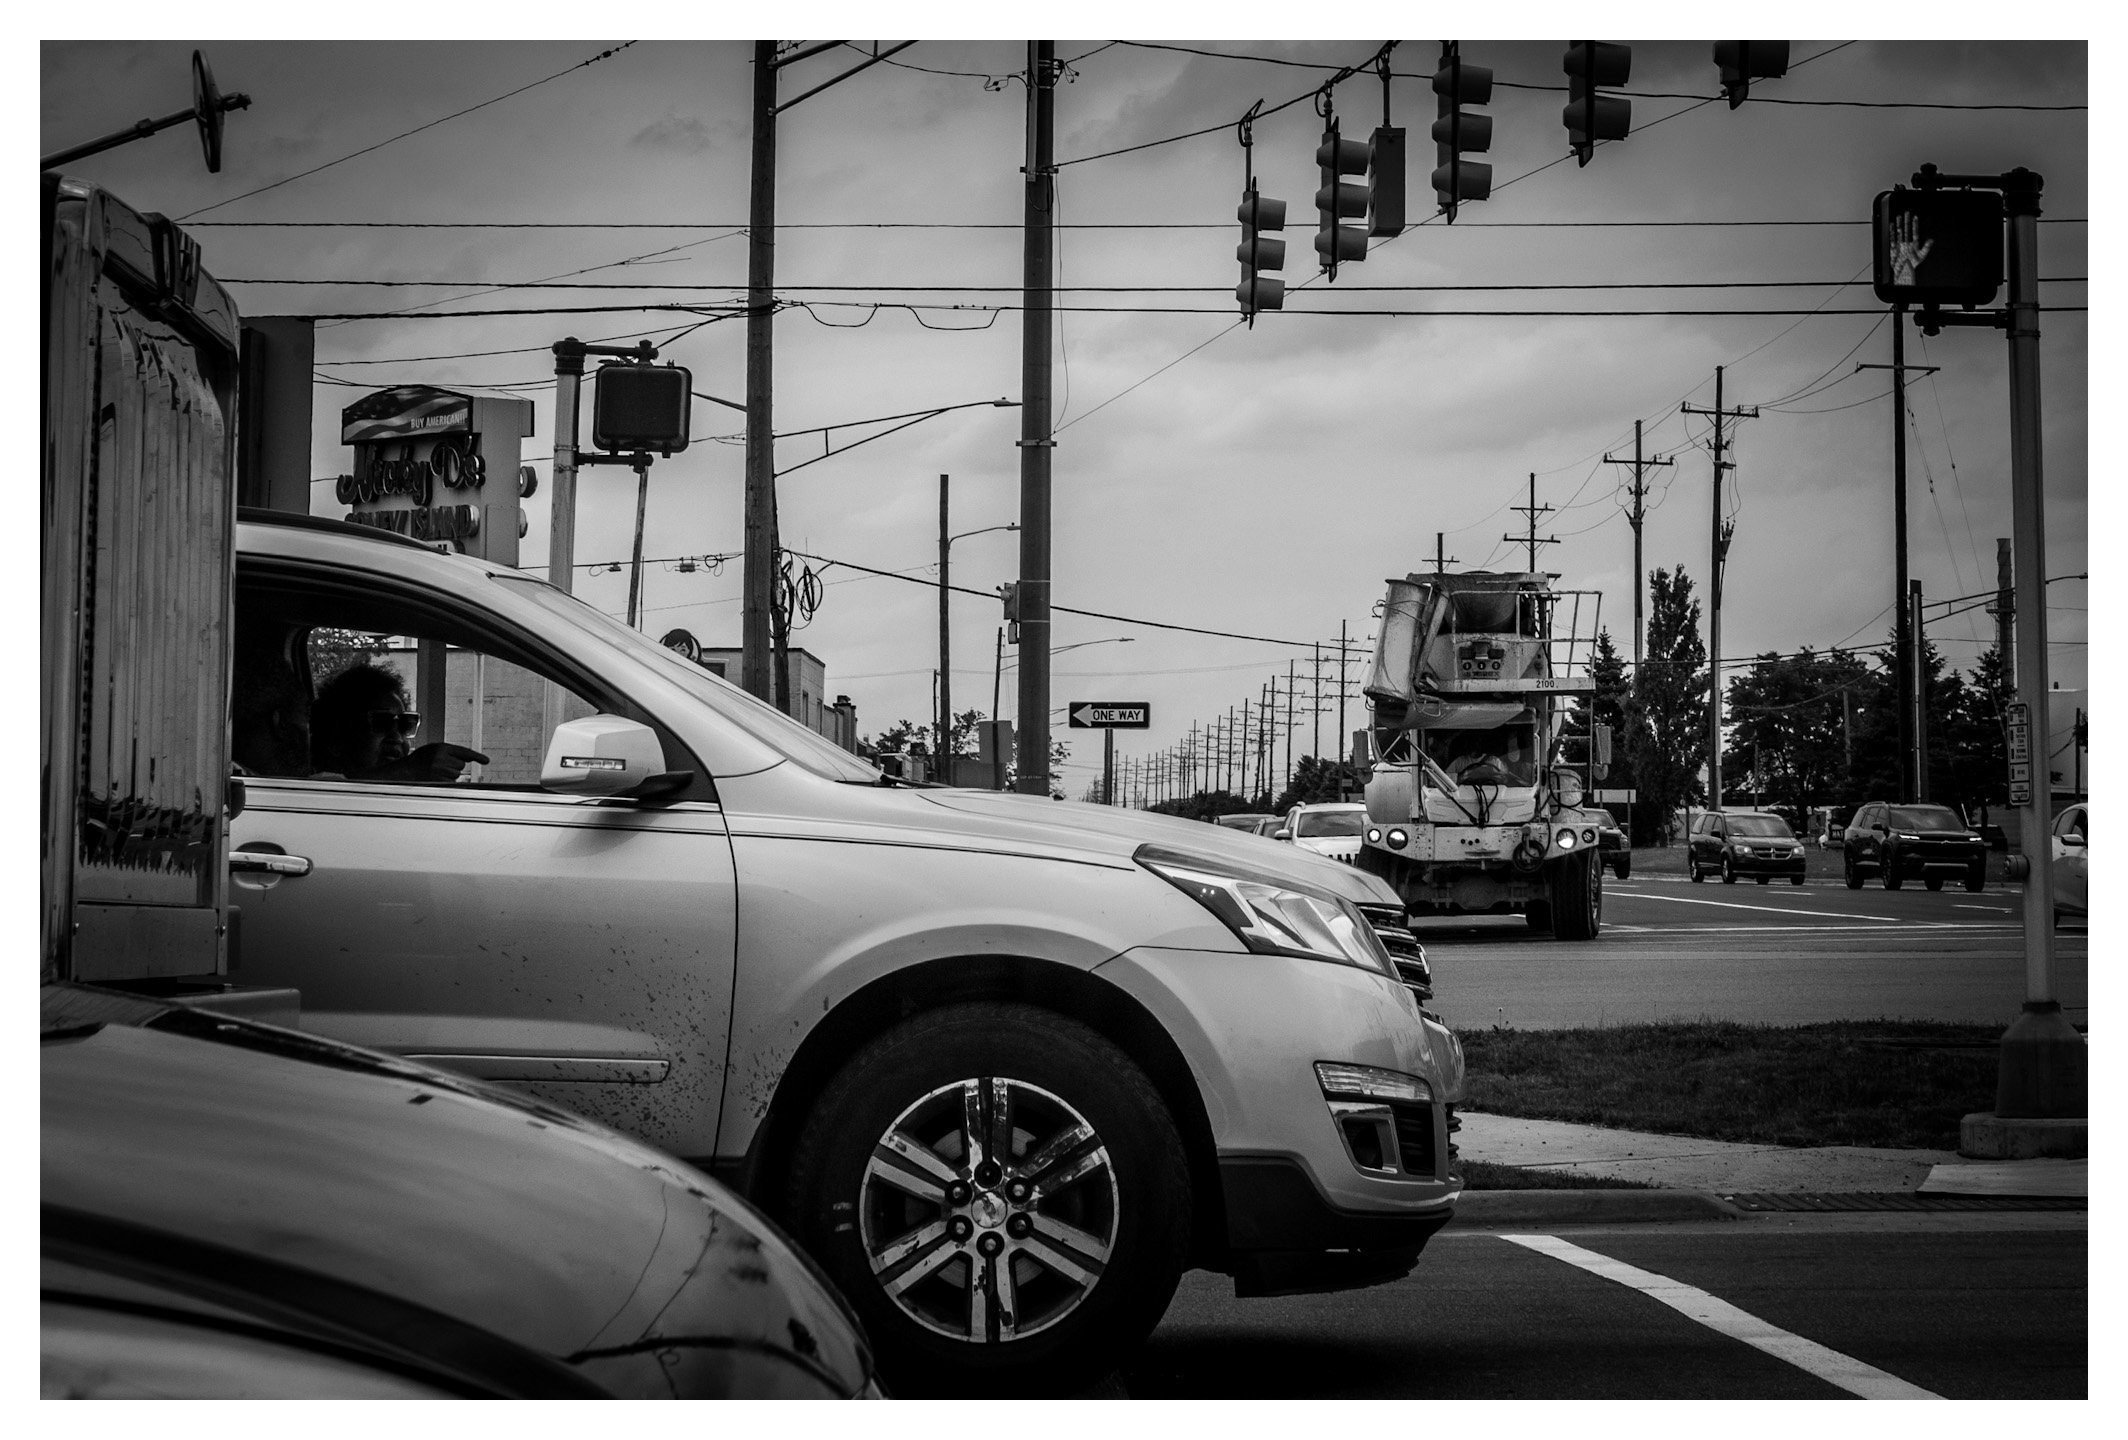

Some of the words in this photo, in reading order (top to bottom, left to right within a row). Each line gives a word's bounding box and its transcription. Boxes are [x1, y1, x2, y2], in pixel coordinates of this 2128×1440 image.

[410, 417, 425, 429] BUY
[1536, 680, 1555, 688] 2100
[1093, 709, 1115, 721] ONE
[1119, 710, 1141, 721] WAY
